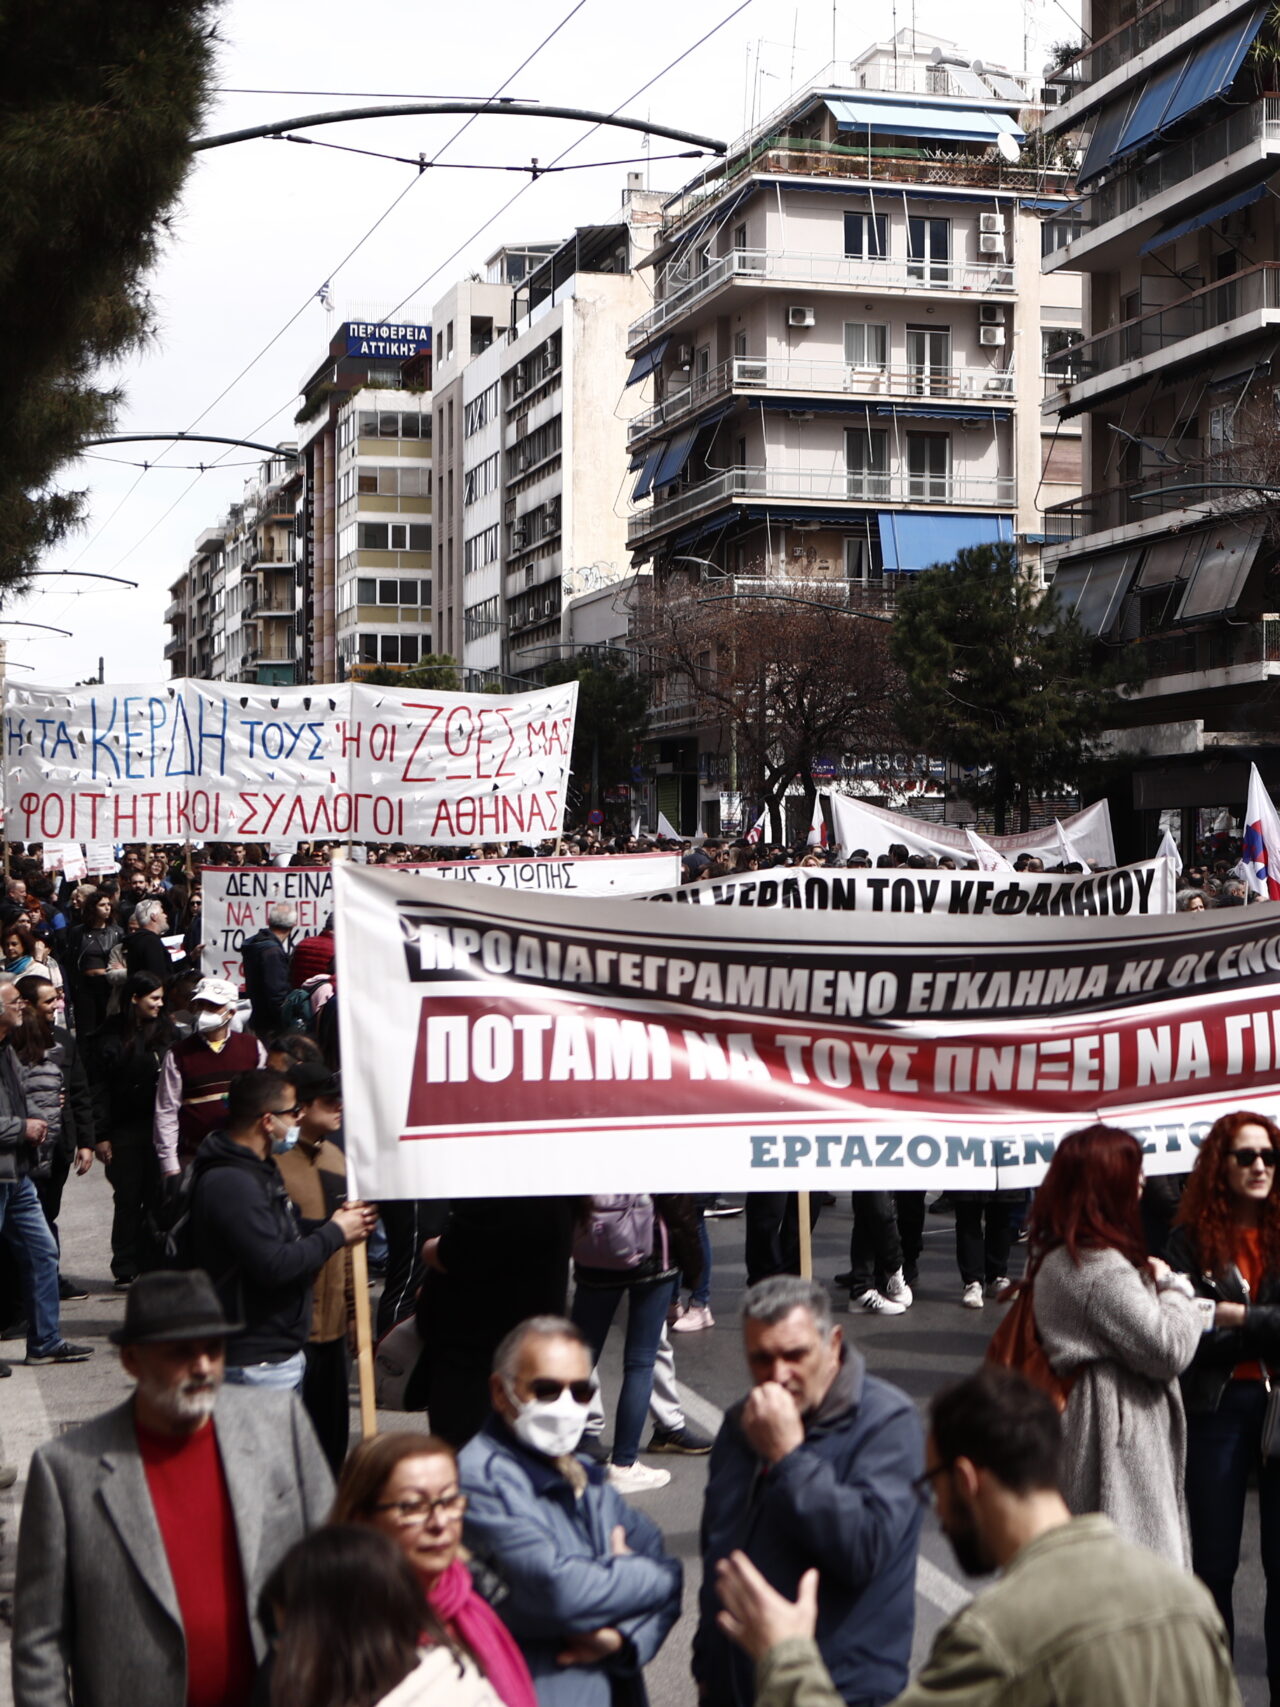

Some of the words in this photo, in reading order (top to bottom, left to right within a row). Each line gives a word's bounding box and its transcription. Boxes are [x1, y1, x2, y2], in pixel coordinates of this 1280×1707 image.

[349, 324, 428, 341] ΠΕΡΙΦΕΡΕΙΑ
[360, 340, 417, 357] ΑΤΤΙΚΗΣ
[36, 718, 78, 760] ΤΑ
[90, 693, 228, 780] ΚΕΡΔΗ
[240, 720, 325, 761] ΤΟΥΣ
[368, 722, 397, 763] ΟΙ
[526, 716, 572, 758] ΜΑΣ
[20, 789, 220, 839] ΦΟΙΤΗΤΙΚΟΙ
[237, 791, 403, 837] ΣΥΛΛΟΓΟΙ
[431, 790, 558, 837] ΑΘΗΝΑΣ
[225, 872, 268, 897] ΔΕΝ
[284, 872, 334, 898] ΕΙΝΑ
[226, 901, 255, 927] ΝΑ
[419, 923, 899, 1018] ΠΡΟΔΙΑΓΕΓΡΑΜΜΕΝΟ
[906, 963, 1116, 1015] ΕΓΚΛΗΜΑ
[1115, 956, 1161, 996] ΚΙ
[1167, 950, 1213, 987] ΟΙ
[426, 1013, 673, 1085] ΠΟΤΑΜΙ
[682, 1027, 772, 1083] ΝΑ
[775, 1033, 918, 1093] ΤΟΥΣ
[933, 1031, 1121, 1093] ΠΝΙΞΕΙ
[1136, 1019, 1212, 1087] ΝΑ
[750, 1132, 1056, 1169] ΕΡΓΑΖΟΜΕΝ
